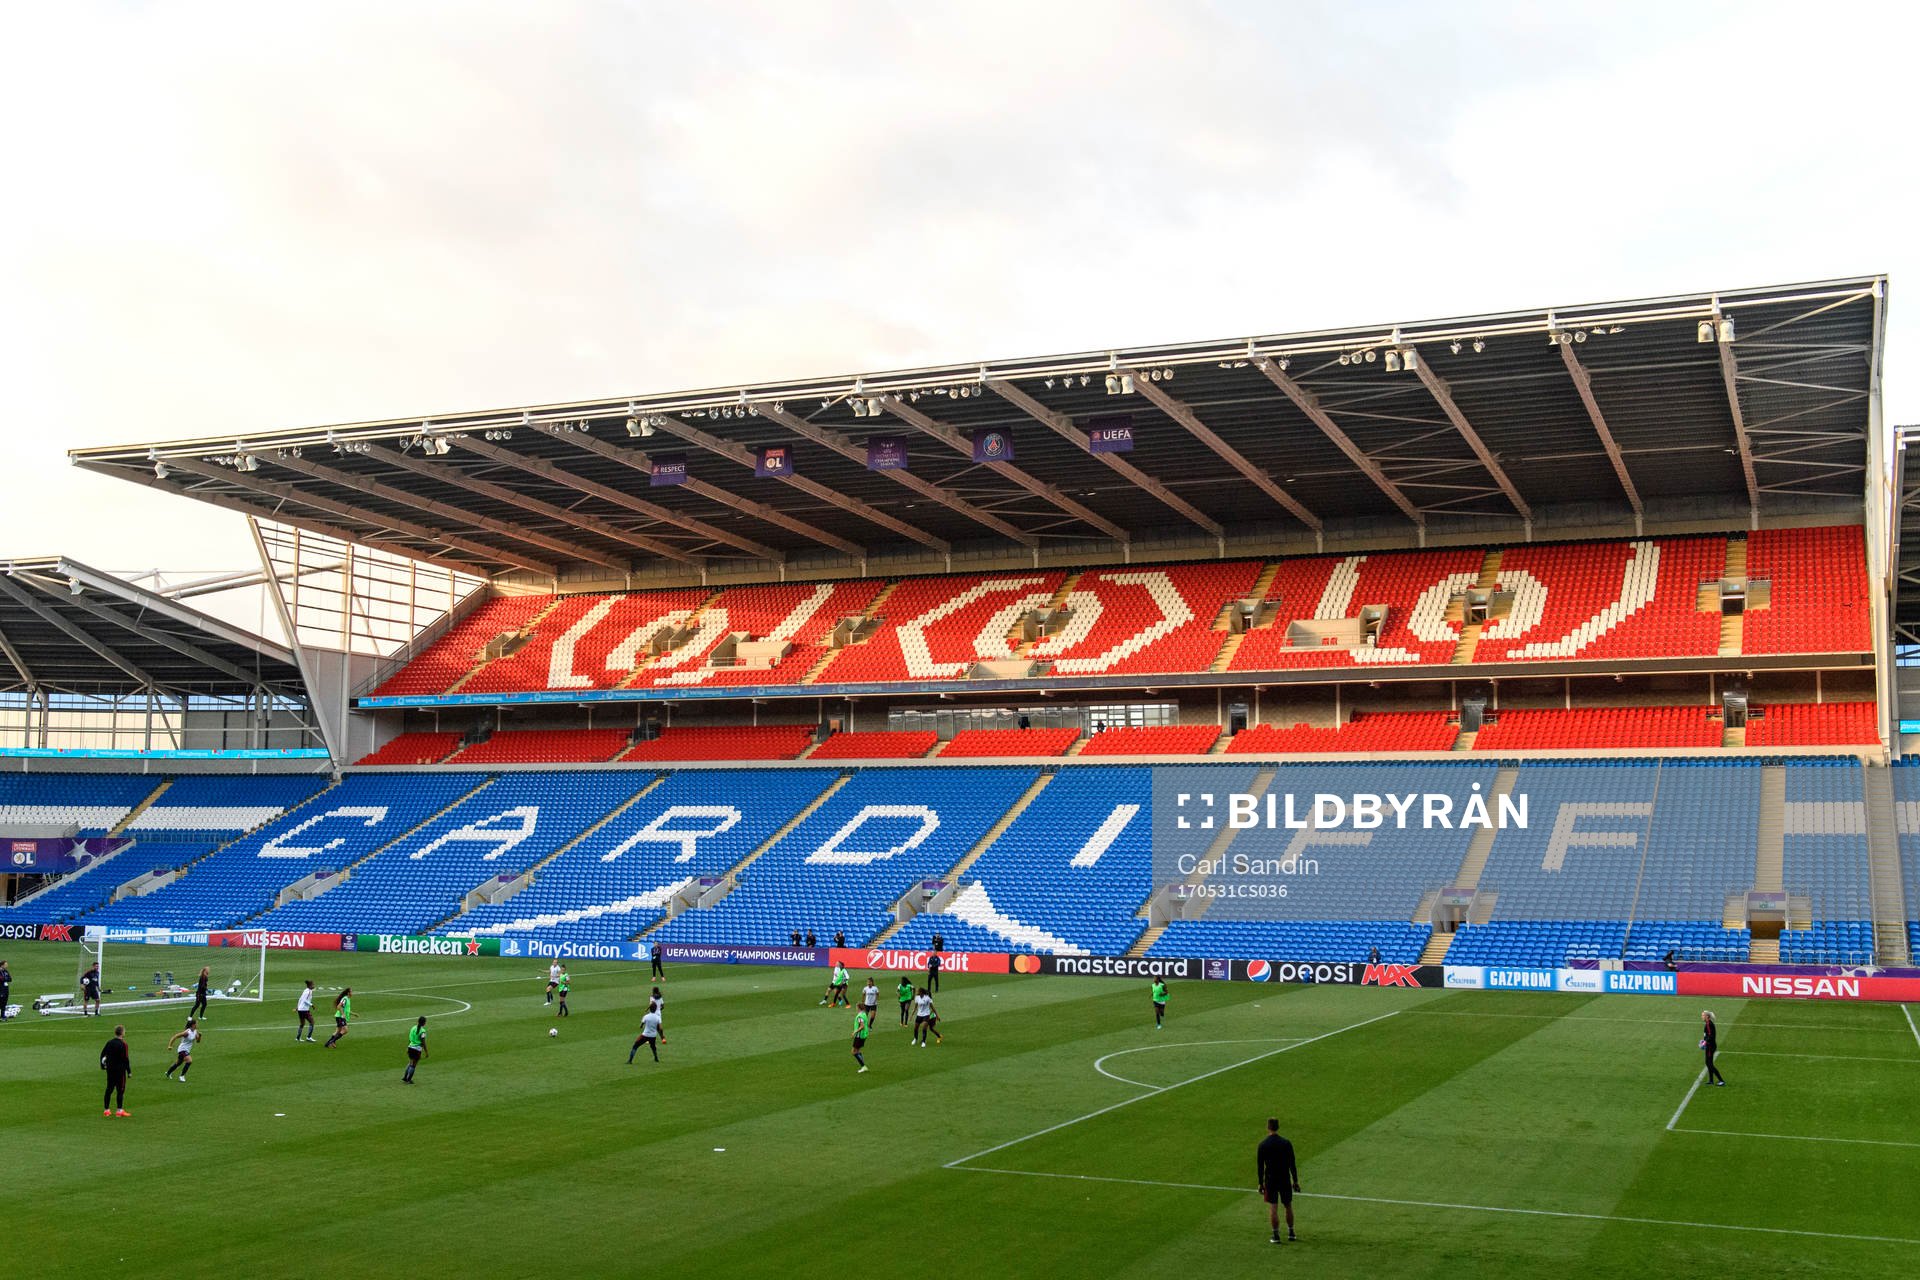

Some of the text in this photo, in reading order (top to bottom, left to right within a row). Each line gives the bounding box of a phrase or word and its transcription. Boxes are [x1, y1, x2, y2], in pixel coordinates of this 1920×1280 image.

[1103, 430, 1131, 440] UEFA
[660, 465, 686, 473] RESPECT
[766, 457, 782, 468] OL
[40, 924, 72, 942] MAX
[243, 933, 305, 947] NISSAN
[378, 935, 463, 955] Heineken
[667, 948, 815, 961] UEFA WOMEN'S CHAMPIONS LEAGUE
[1056, 956, 1188, 976] mastercard
[1280, 963, 1423, 987] pepsi MAX
[1490, 971, 1550, 987] GAZPROM
[1610, 974, 1674, 991] GAZPROM
[1742, 976, 1859, 997] NISSAN
